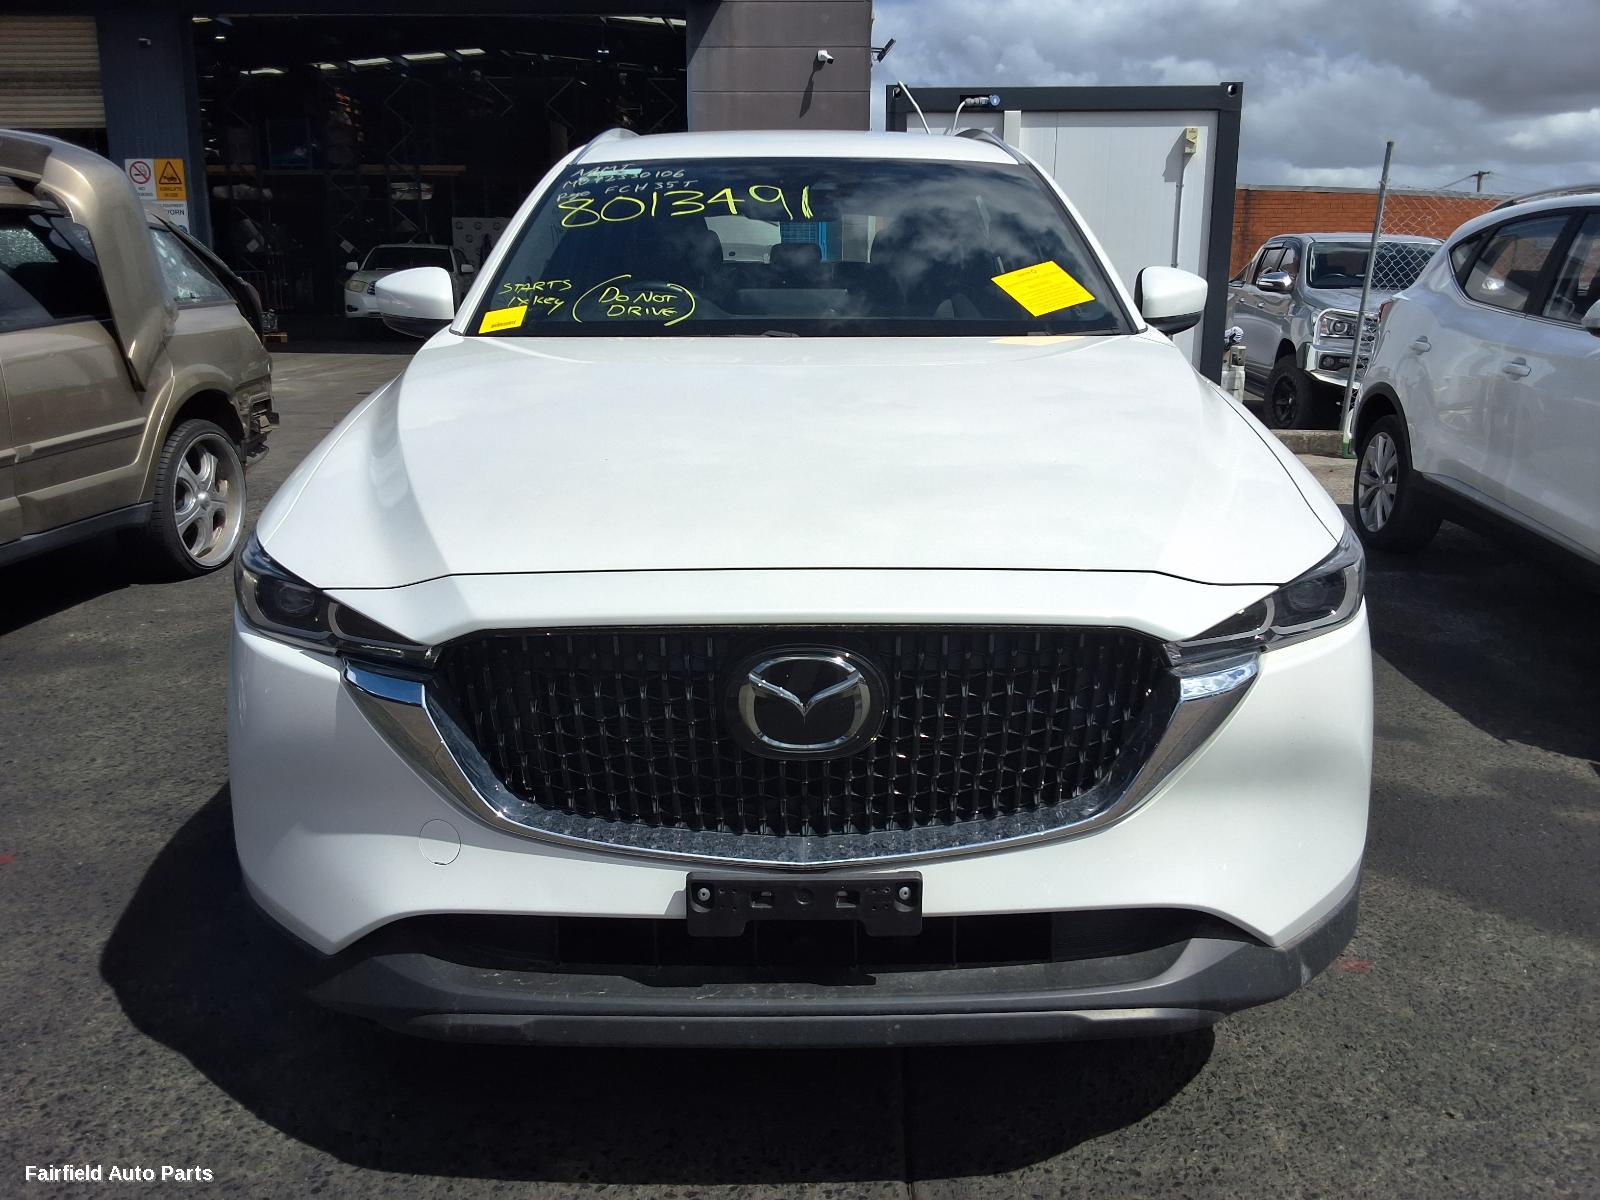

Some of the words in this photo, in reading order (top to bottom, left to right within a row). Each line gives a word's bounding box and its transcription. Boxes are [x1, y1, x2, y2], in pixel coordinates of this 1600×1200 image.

[558, 185, 814, 228] 8013491
[498, 279, 573, 295] STARTS
[633, 291, 678, 304] NOT
[606, 304, 678, 317] DRIVE
